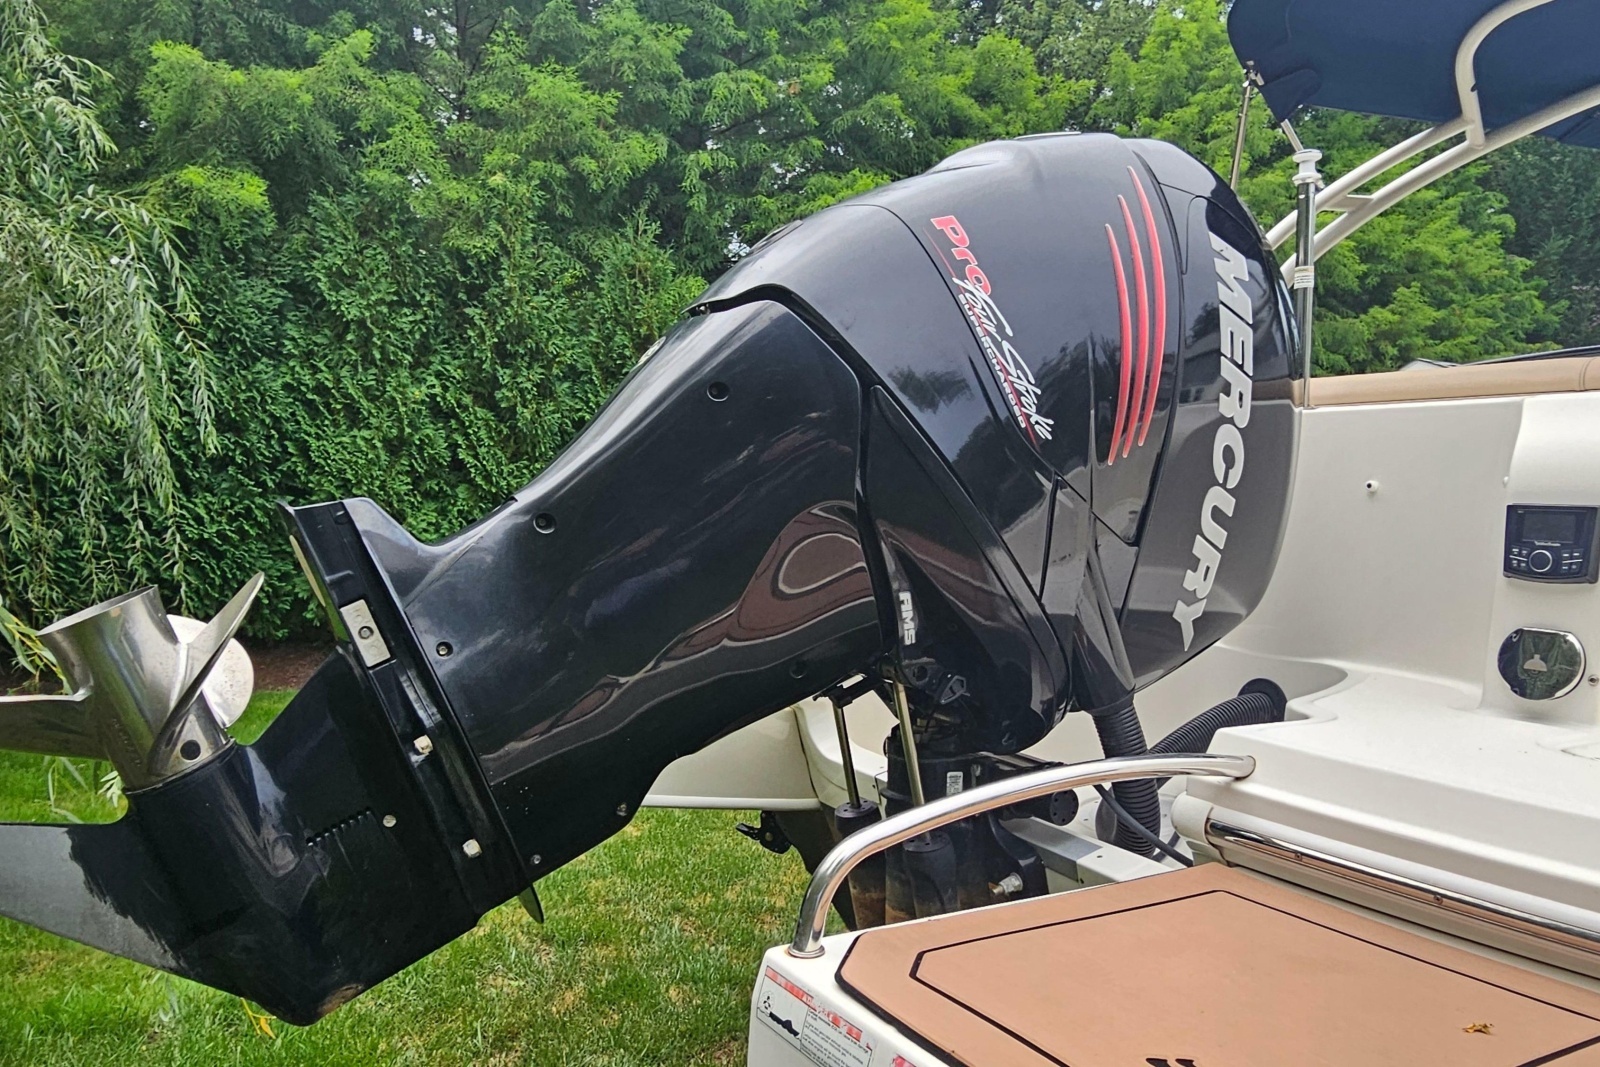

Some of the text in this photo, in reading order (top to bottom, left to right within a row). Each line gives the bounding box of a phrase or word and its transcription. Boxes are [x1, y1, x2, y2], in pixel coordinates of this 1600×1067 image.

[958, 293, 1027, 429] SUPERCHARGED
[1172, 231, 1253, 651] MERCURY
[898, 591, 917, 646] AMS
